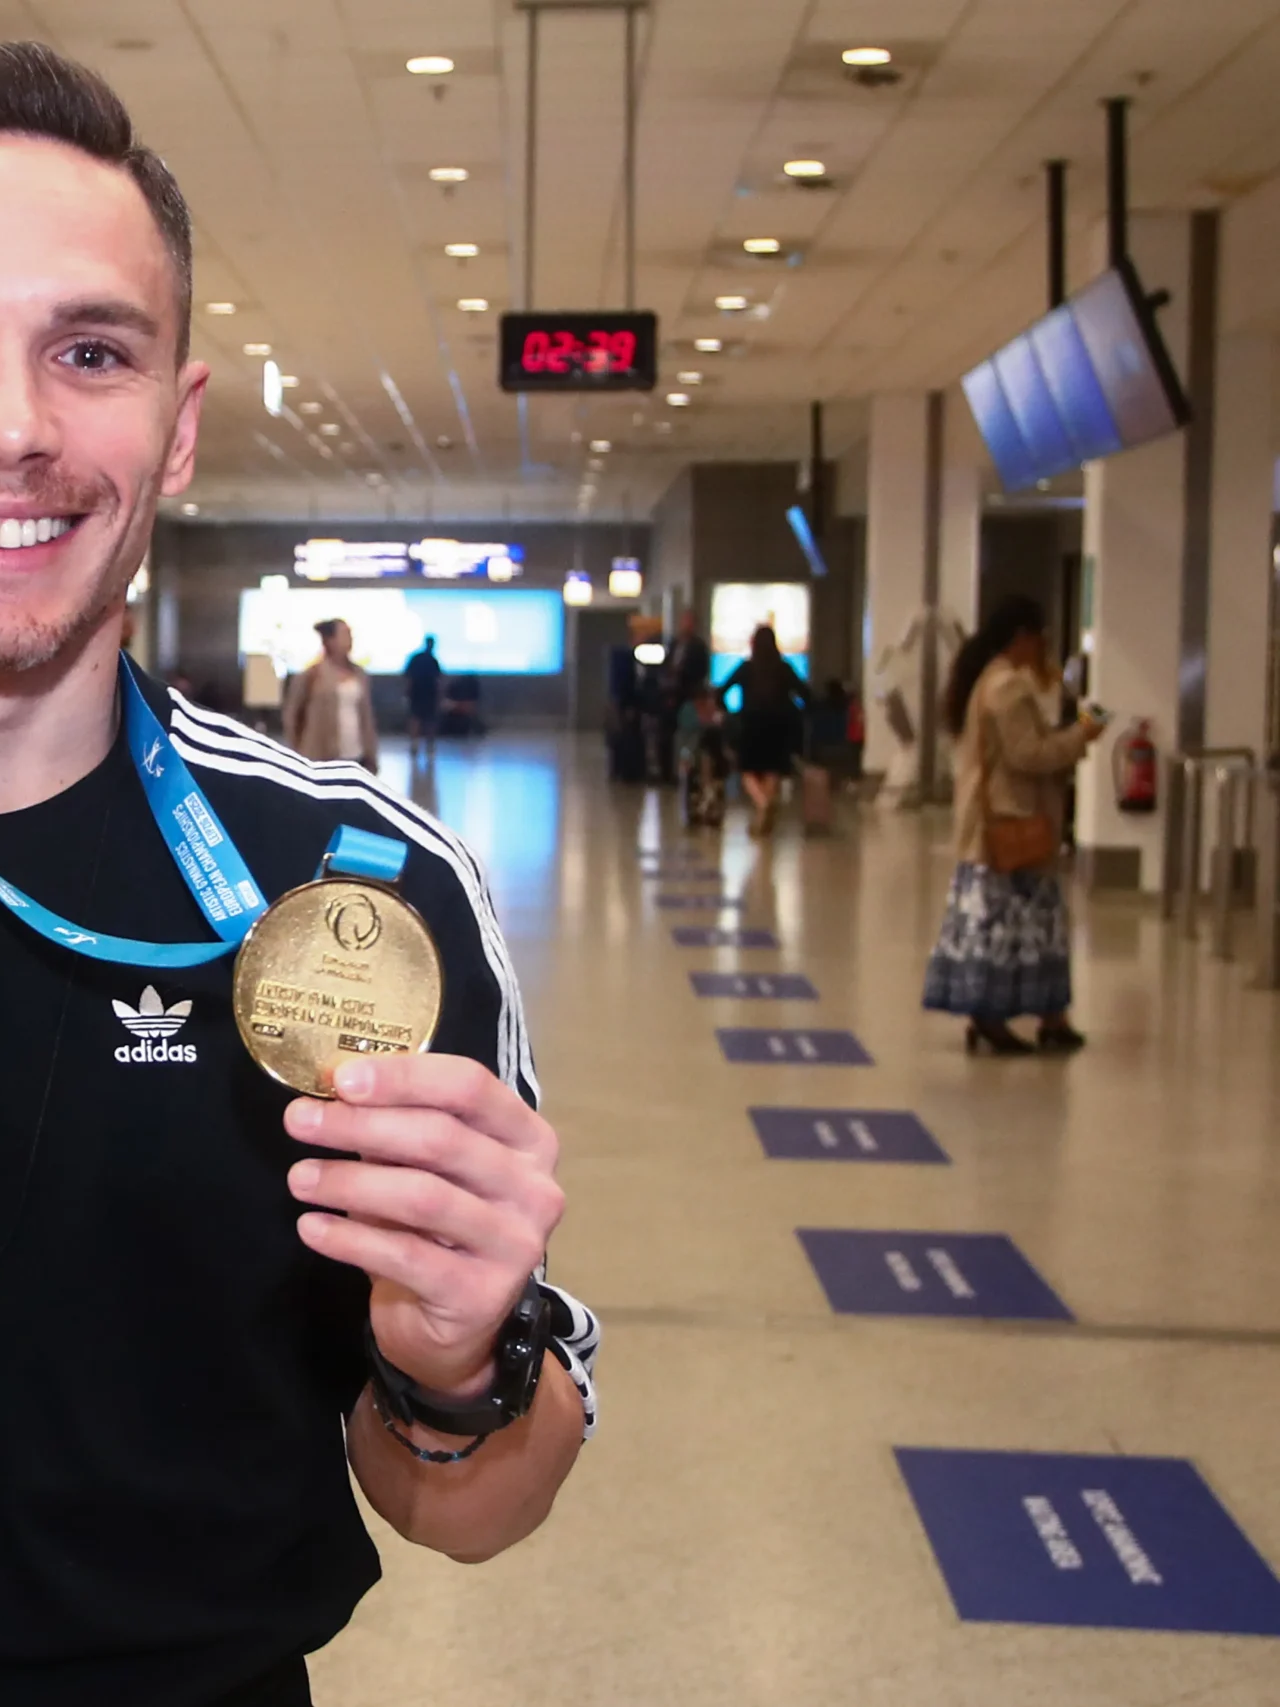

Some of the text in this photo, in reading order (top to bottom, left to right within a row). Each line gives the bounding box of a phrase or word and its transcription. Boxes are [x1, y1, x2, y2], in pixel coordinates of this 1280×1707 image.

[171, 803, 243, 916] EUROPEAN CHAMPIONSHIPS
[174, 840, 227, 922] ARTISTIC GYMNASTICS
[114, 1038, 197, 1063] adidas
